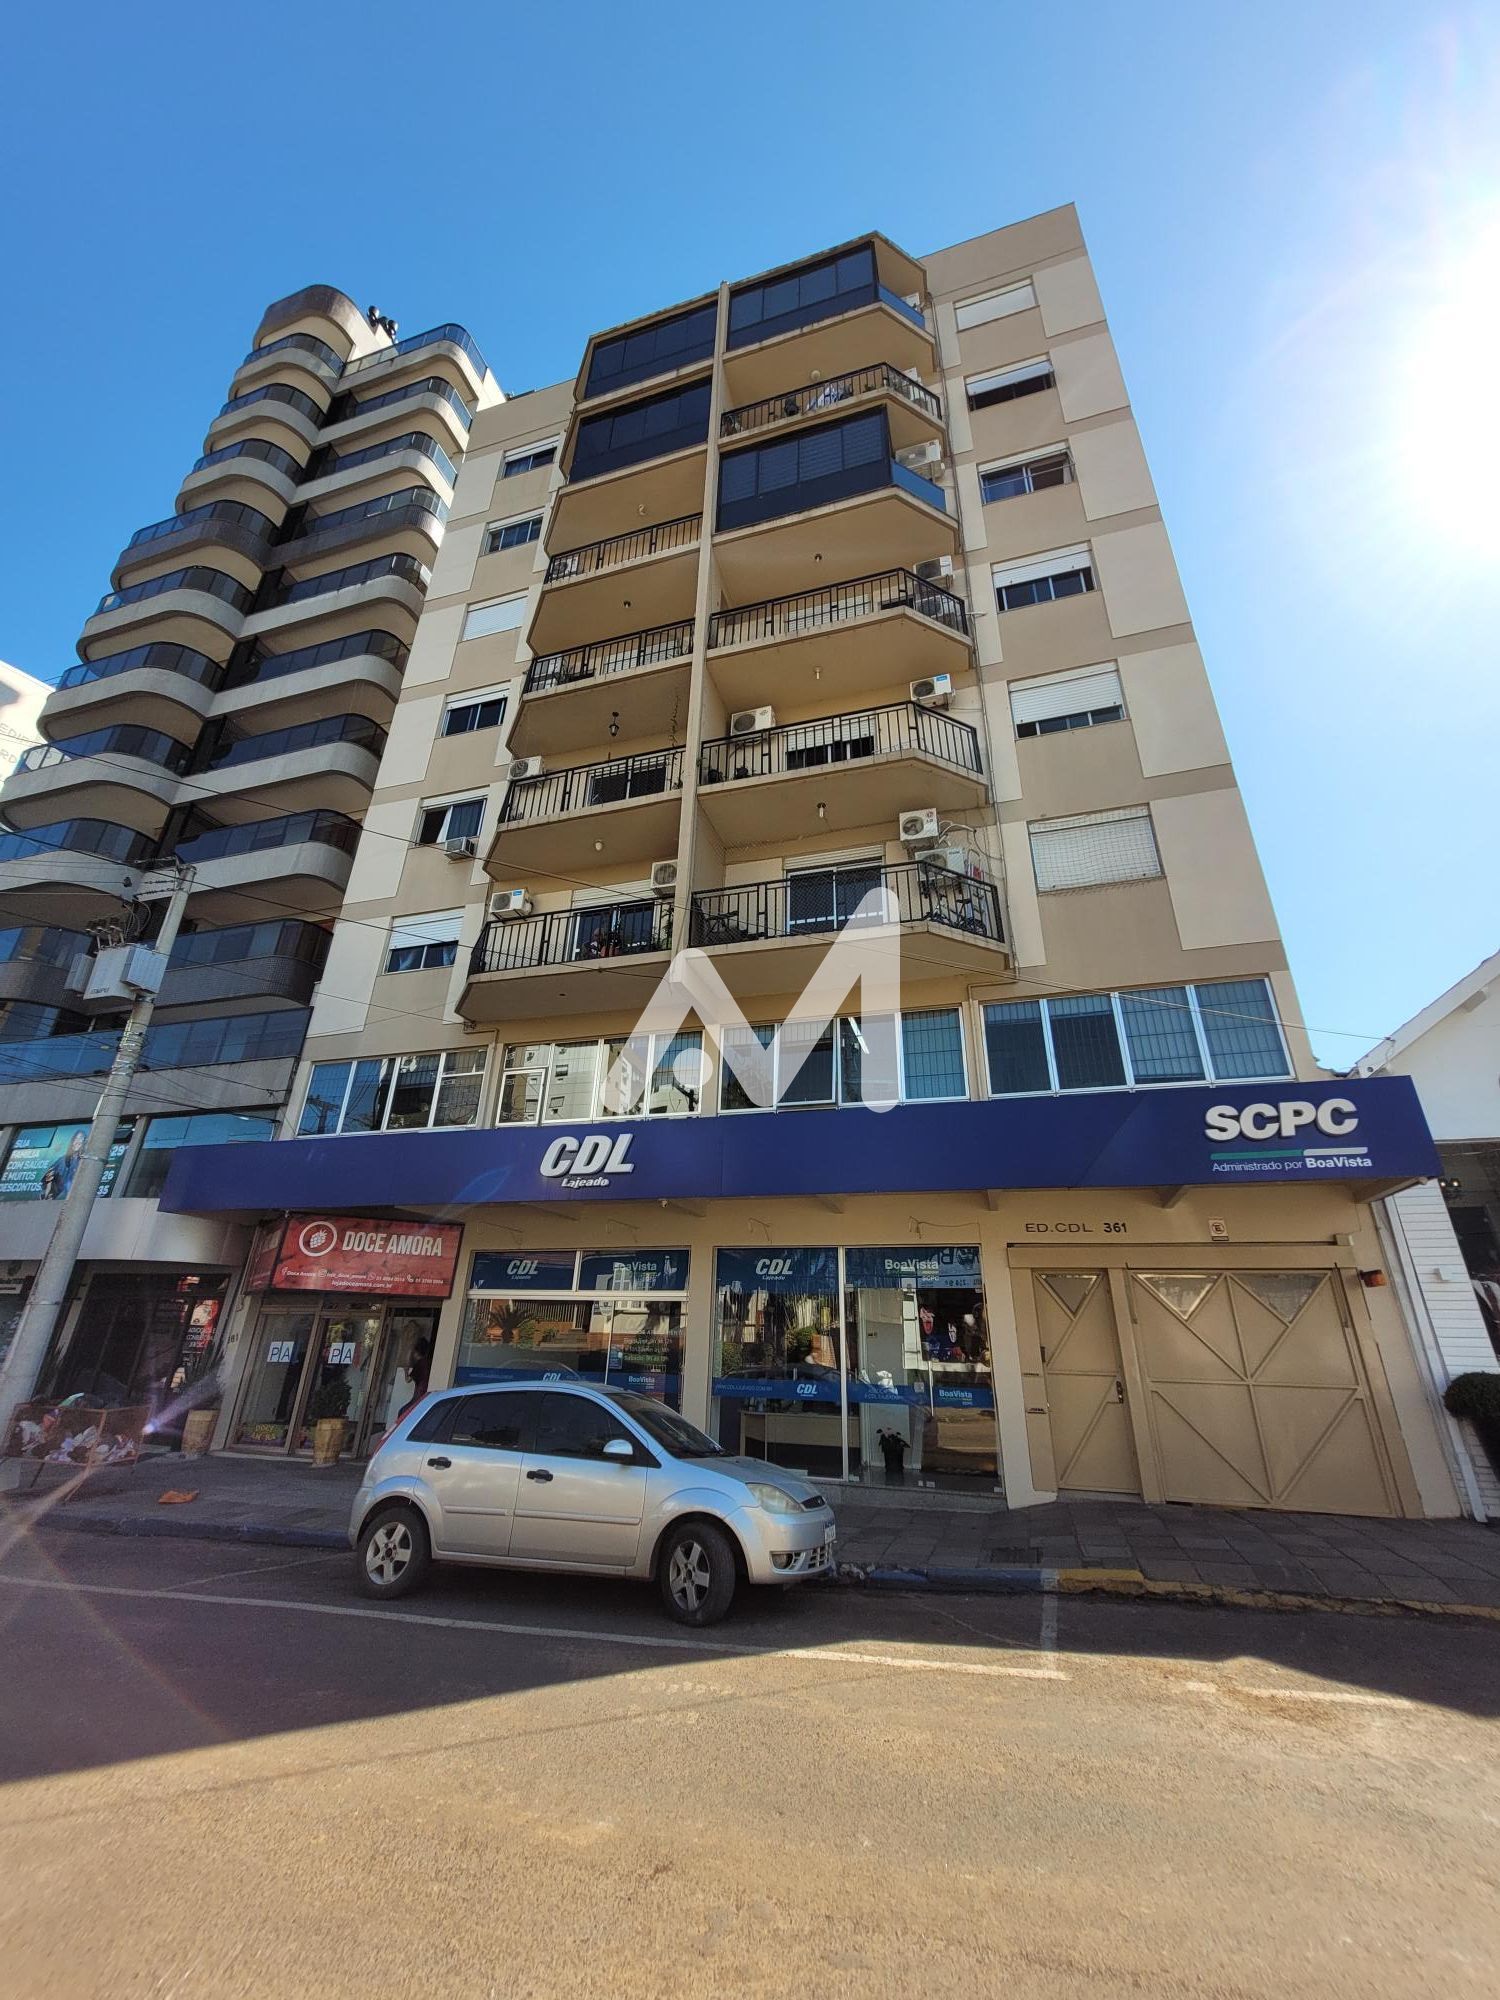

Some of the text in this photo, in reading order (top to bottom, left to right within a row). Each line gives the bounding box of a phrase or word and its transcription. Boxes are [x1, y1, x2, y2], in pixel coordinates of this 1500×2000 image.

[1203, 1097, 1359, 1143] SCPC
[539, 1133, 635, 1177] CDL
[1212, 1156, 1373, 1172] Administrado por BoaVista
[8, 1171, 37, 1180] MUITOS
[561, 1176, 610, 1189] Lajeado
[1103, 1222, 1127, 1233] 361
[342, 1230, 443, 1256] DOCE AMORA
[507, 1259, 539, 1275] CDL
[755, 1258, 793, 1275] CDL
[884, 1258, 939, 1270] BoaVista
[796, 1382, 818, 1394] CDL
[938, 1389, 973, 1399] BoaVista
